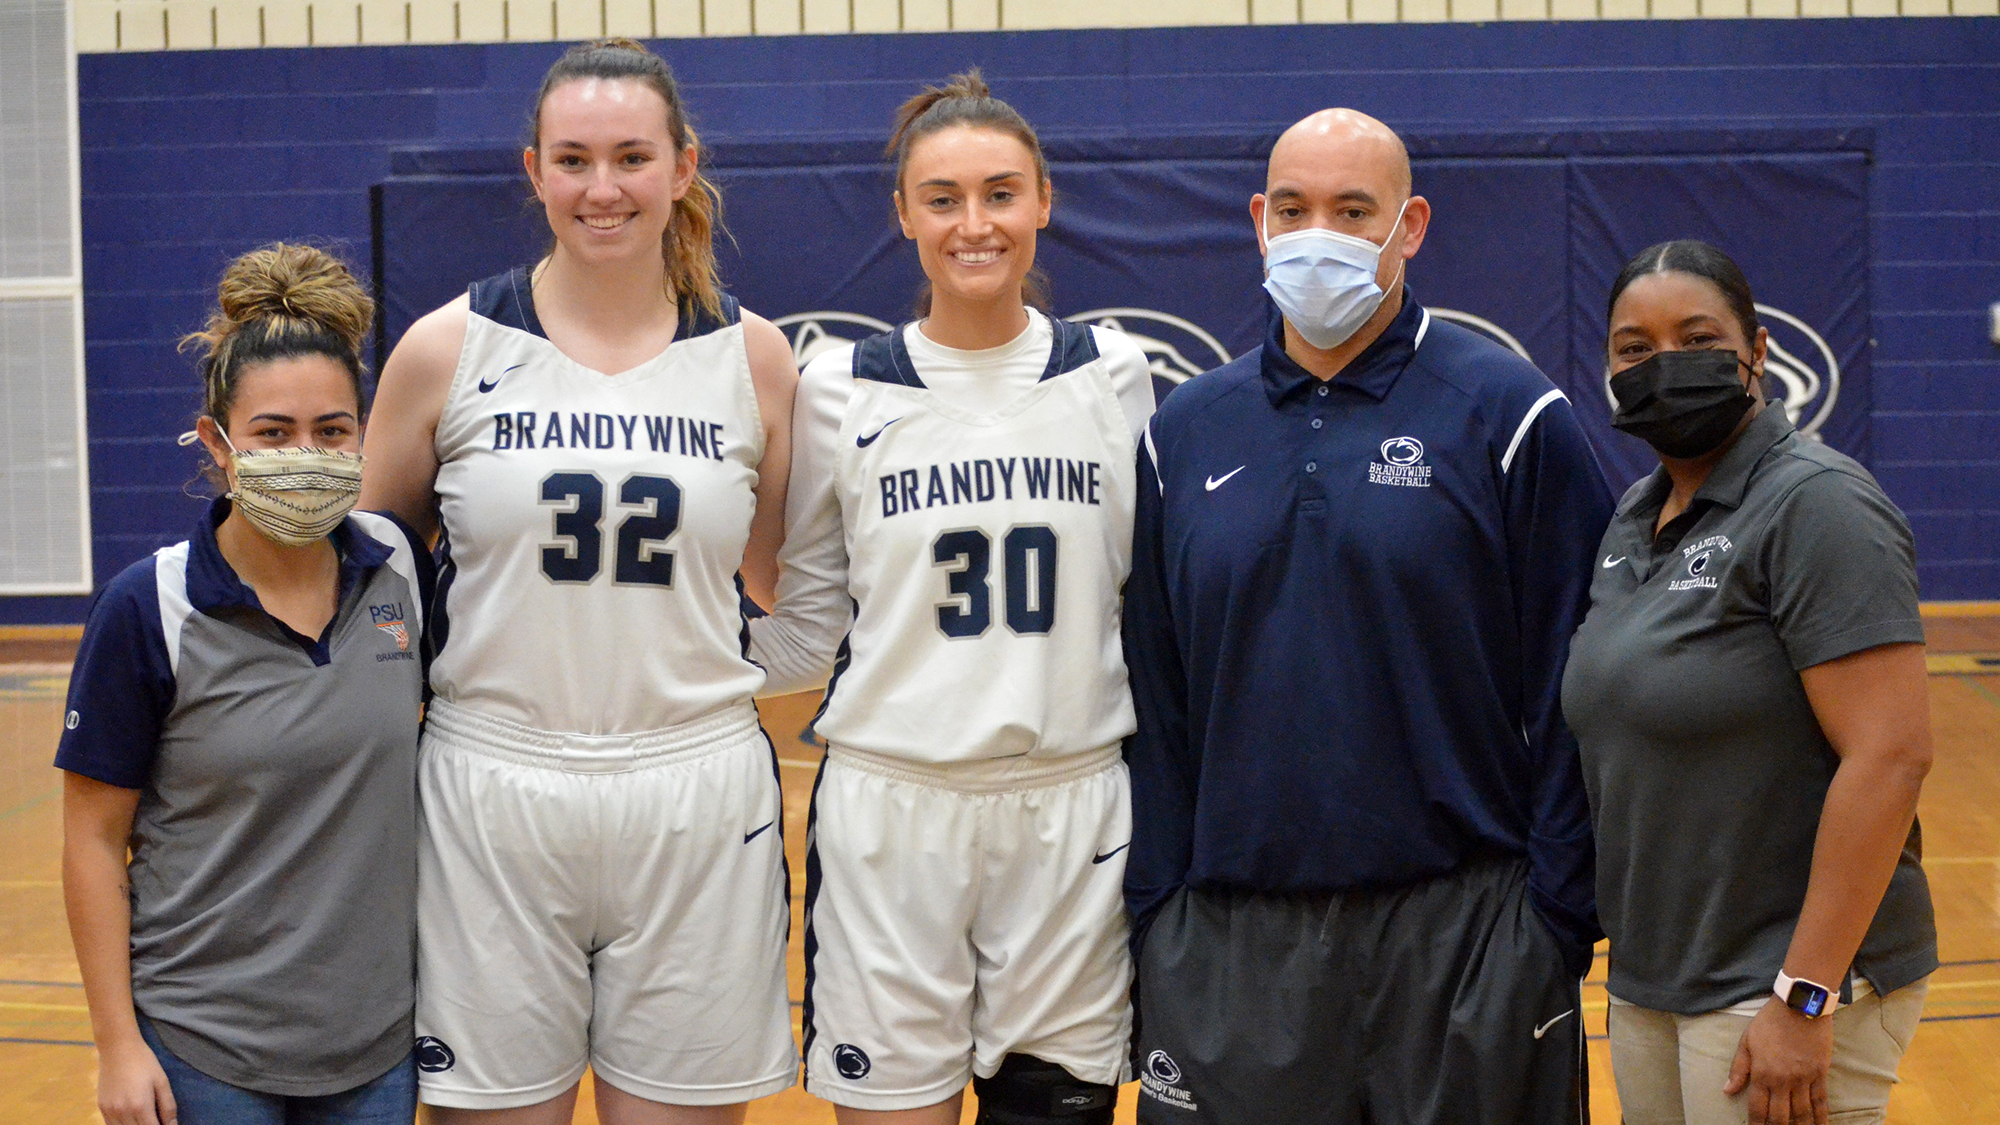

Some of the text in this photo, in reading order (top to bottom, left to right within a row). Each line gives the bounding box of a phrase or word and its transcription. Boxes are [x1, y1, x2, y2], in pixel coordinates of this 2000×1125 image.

[493, 411, 725, 463] BRANDYWINE
[1368, 462, 1432, 478] BRANDYWINE
[1368, 473, 1431, 488] BASKETBALL
[879, 457, 1100, 519] BRANDYWINE
[537, 469, 686, 591] 32
[1682, 535, 1733, 559] BRANDYNE
[929, 522, 1061, 642] 30
[369, 602, 404, 624] PSU
[1141, 1069, 1192, 1101] BRANDYWINE
[1158, 1093, 1198, 1112] Basketball
